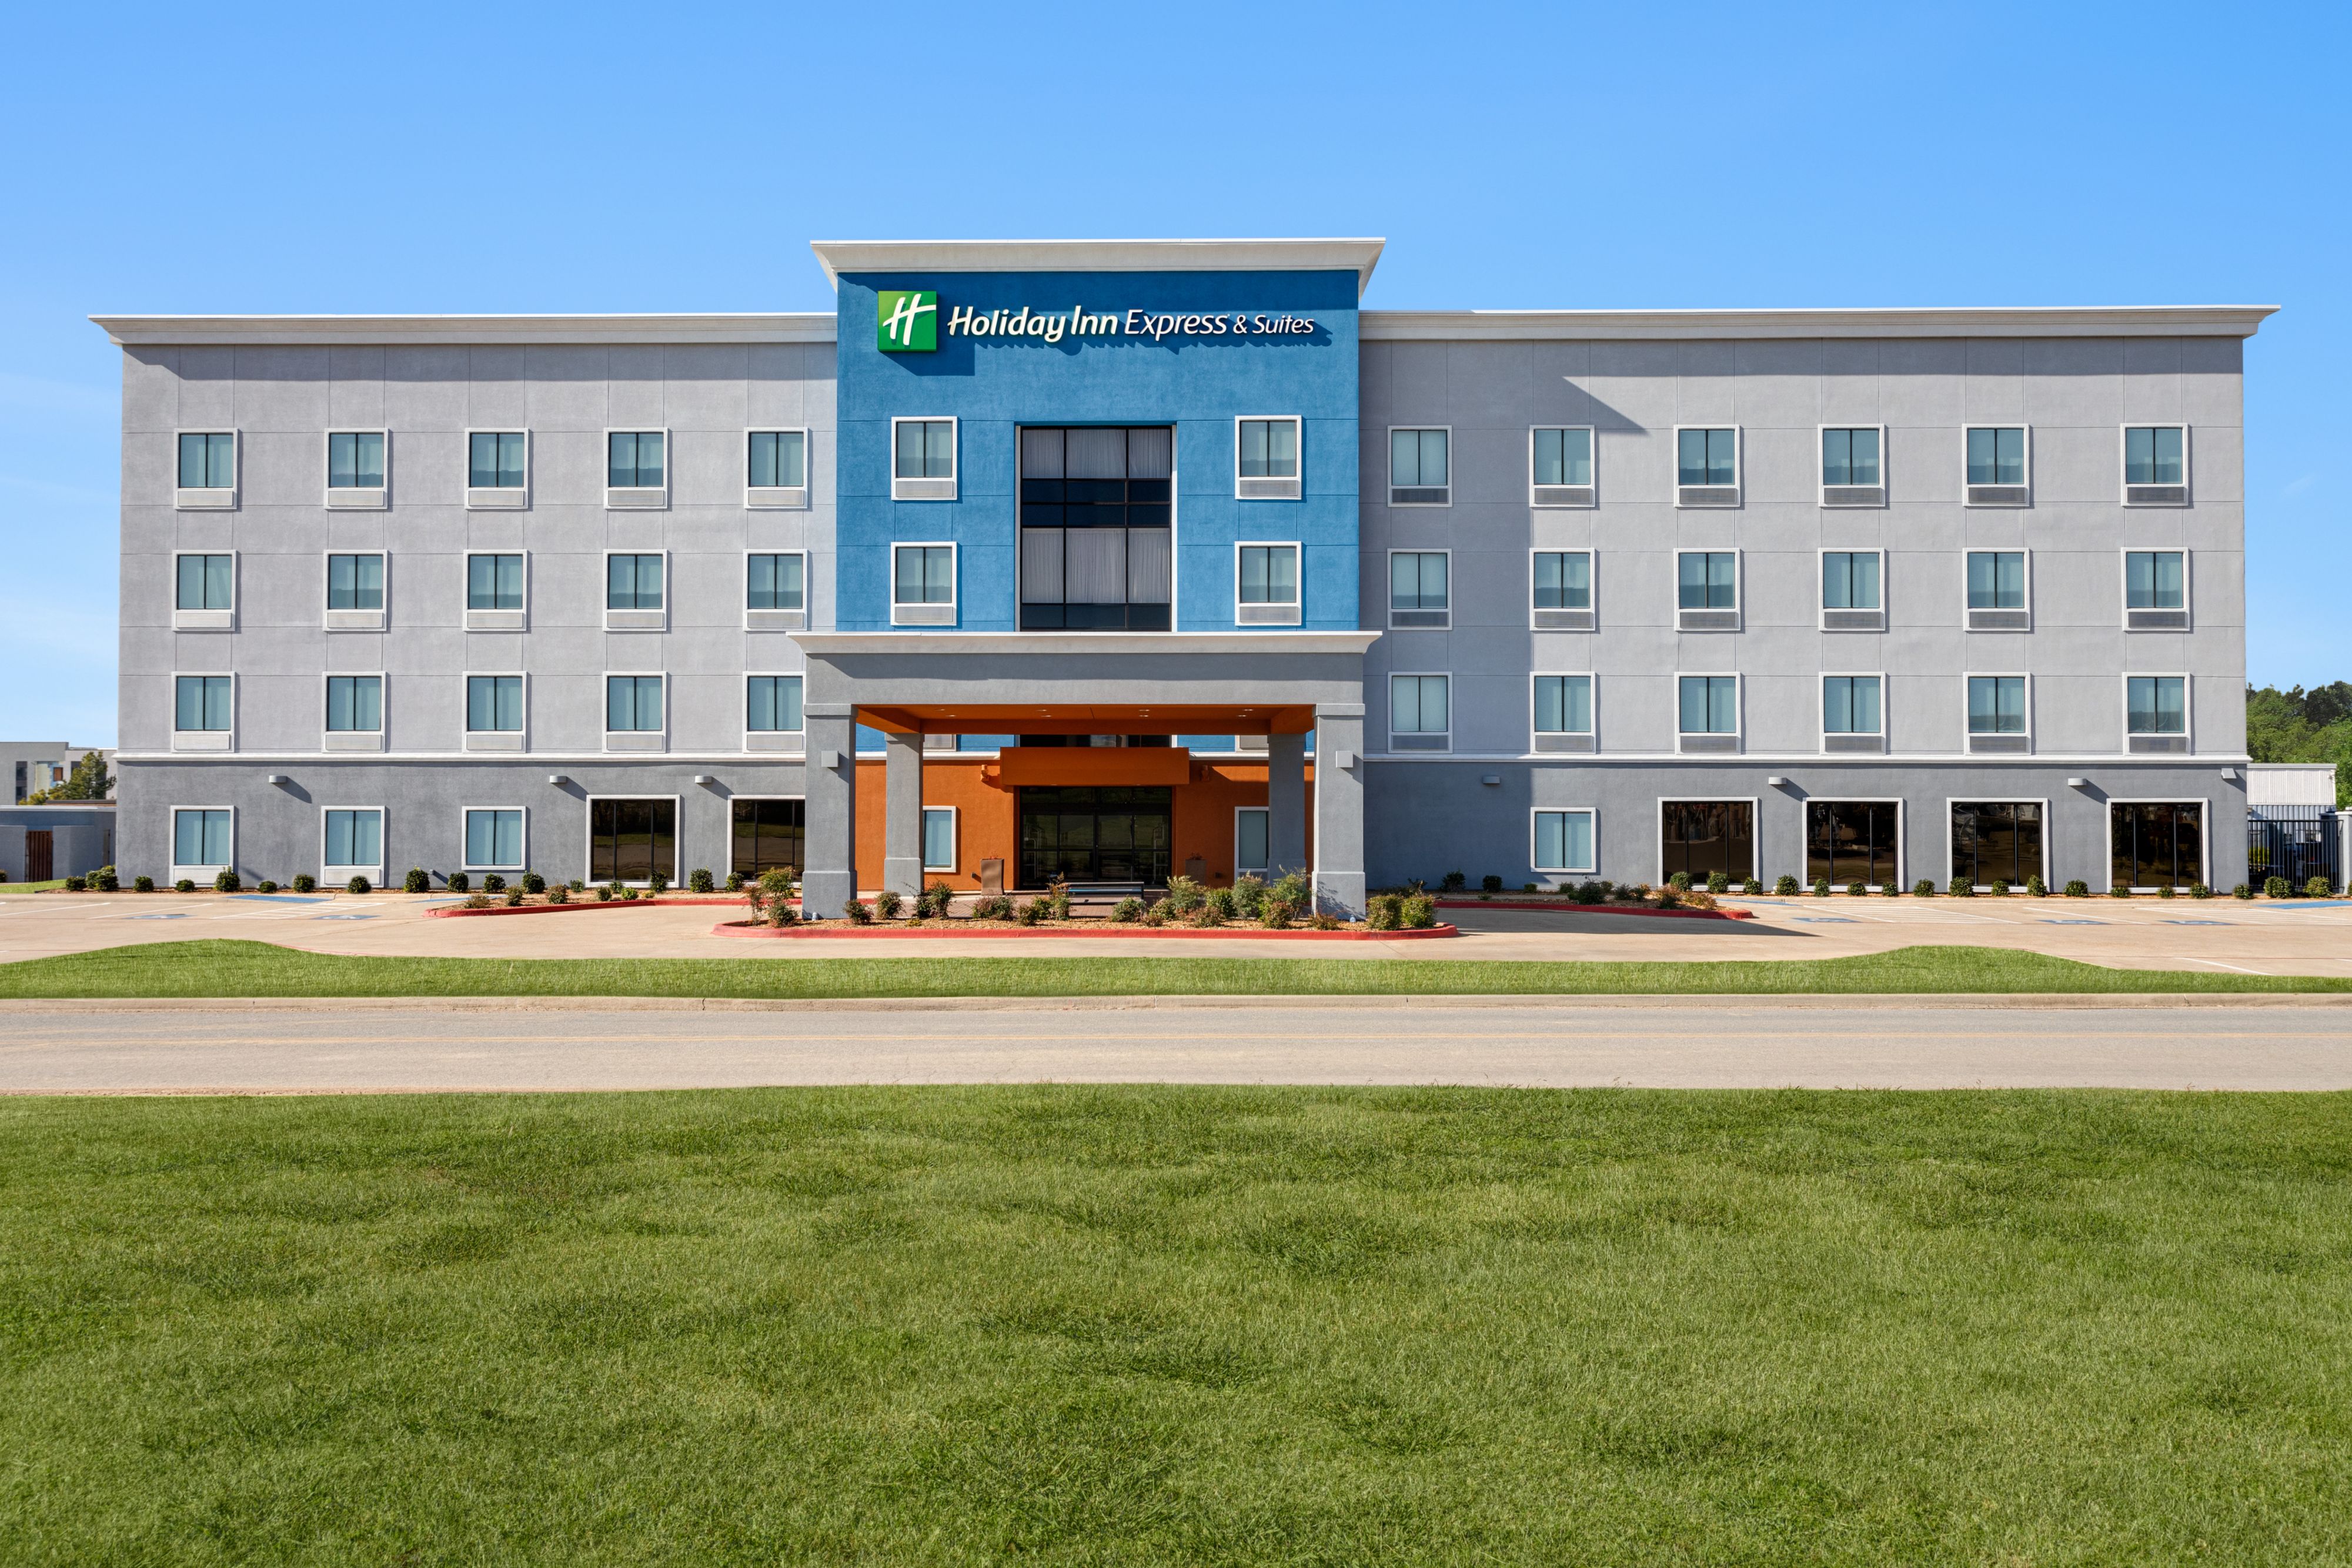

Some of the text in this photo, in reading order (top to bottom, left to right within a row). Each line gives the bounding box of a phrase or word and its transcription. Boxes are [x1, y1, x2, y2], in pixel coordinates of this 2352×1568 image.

[947, 305, 1314, 343] Holiday Inn Express & Suites
